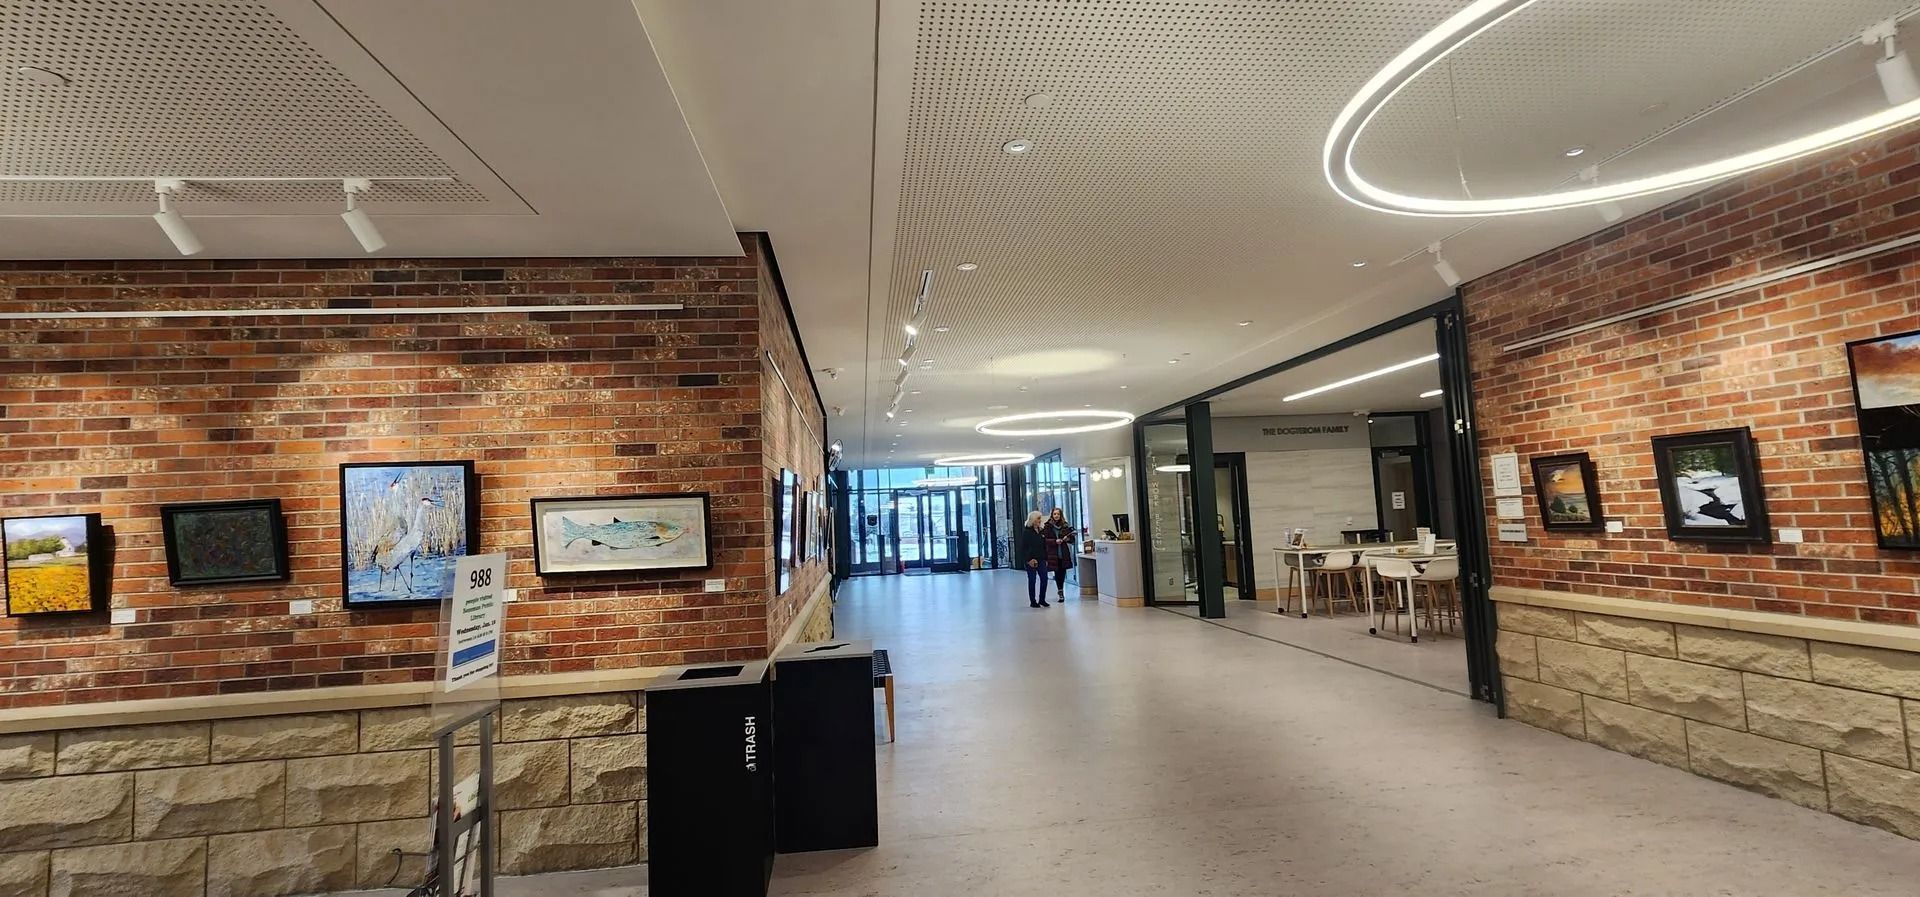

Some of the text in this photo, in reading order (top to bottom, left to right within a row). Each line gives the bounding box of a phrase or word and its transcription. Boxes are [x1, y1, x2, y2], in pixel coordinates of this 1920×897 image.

[1262, 428, 1276, 436] THE
[1322, 425, 1349, 434] FAMILY
[470, 567, 492, 590] 988
[745, 716, 756, 762] TRASH
